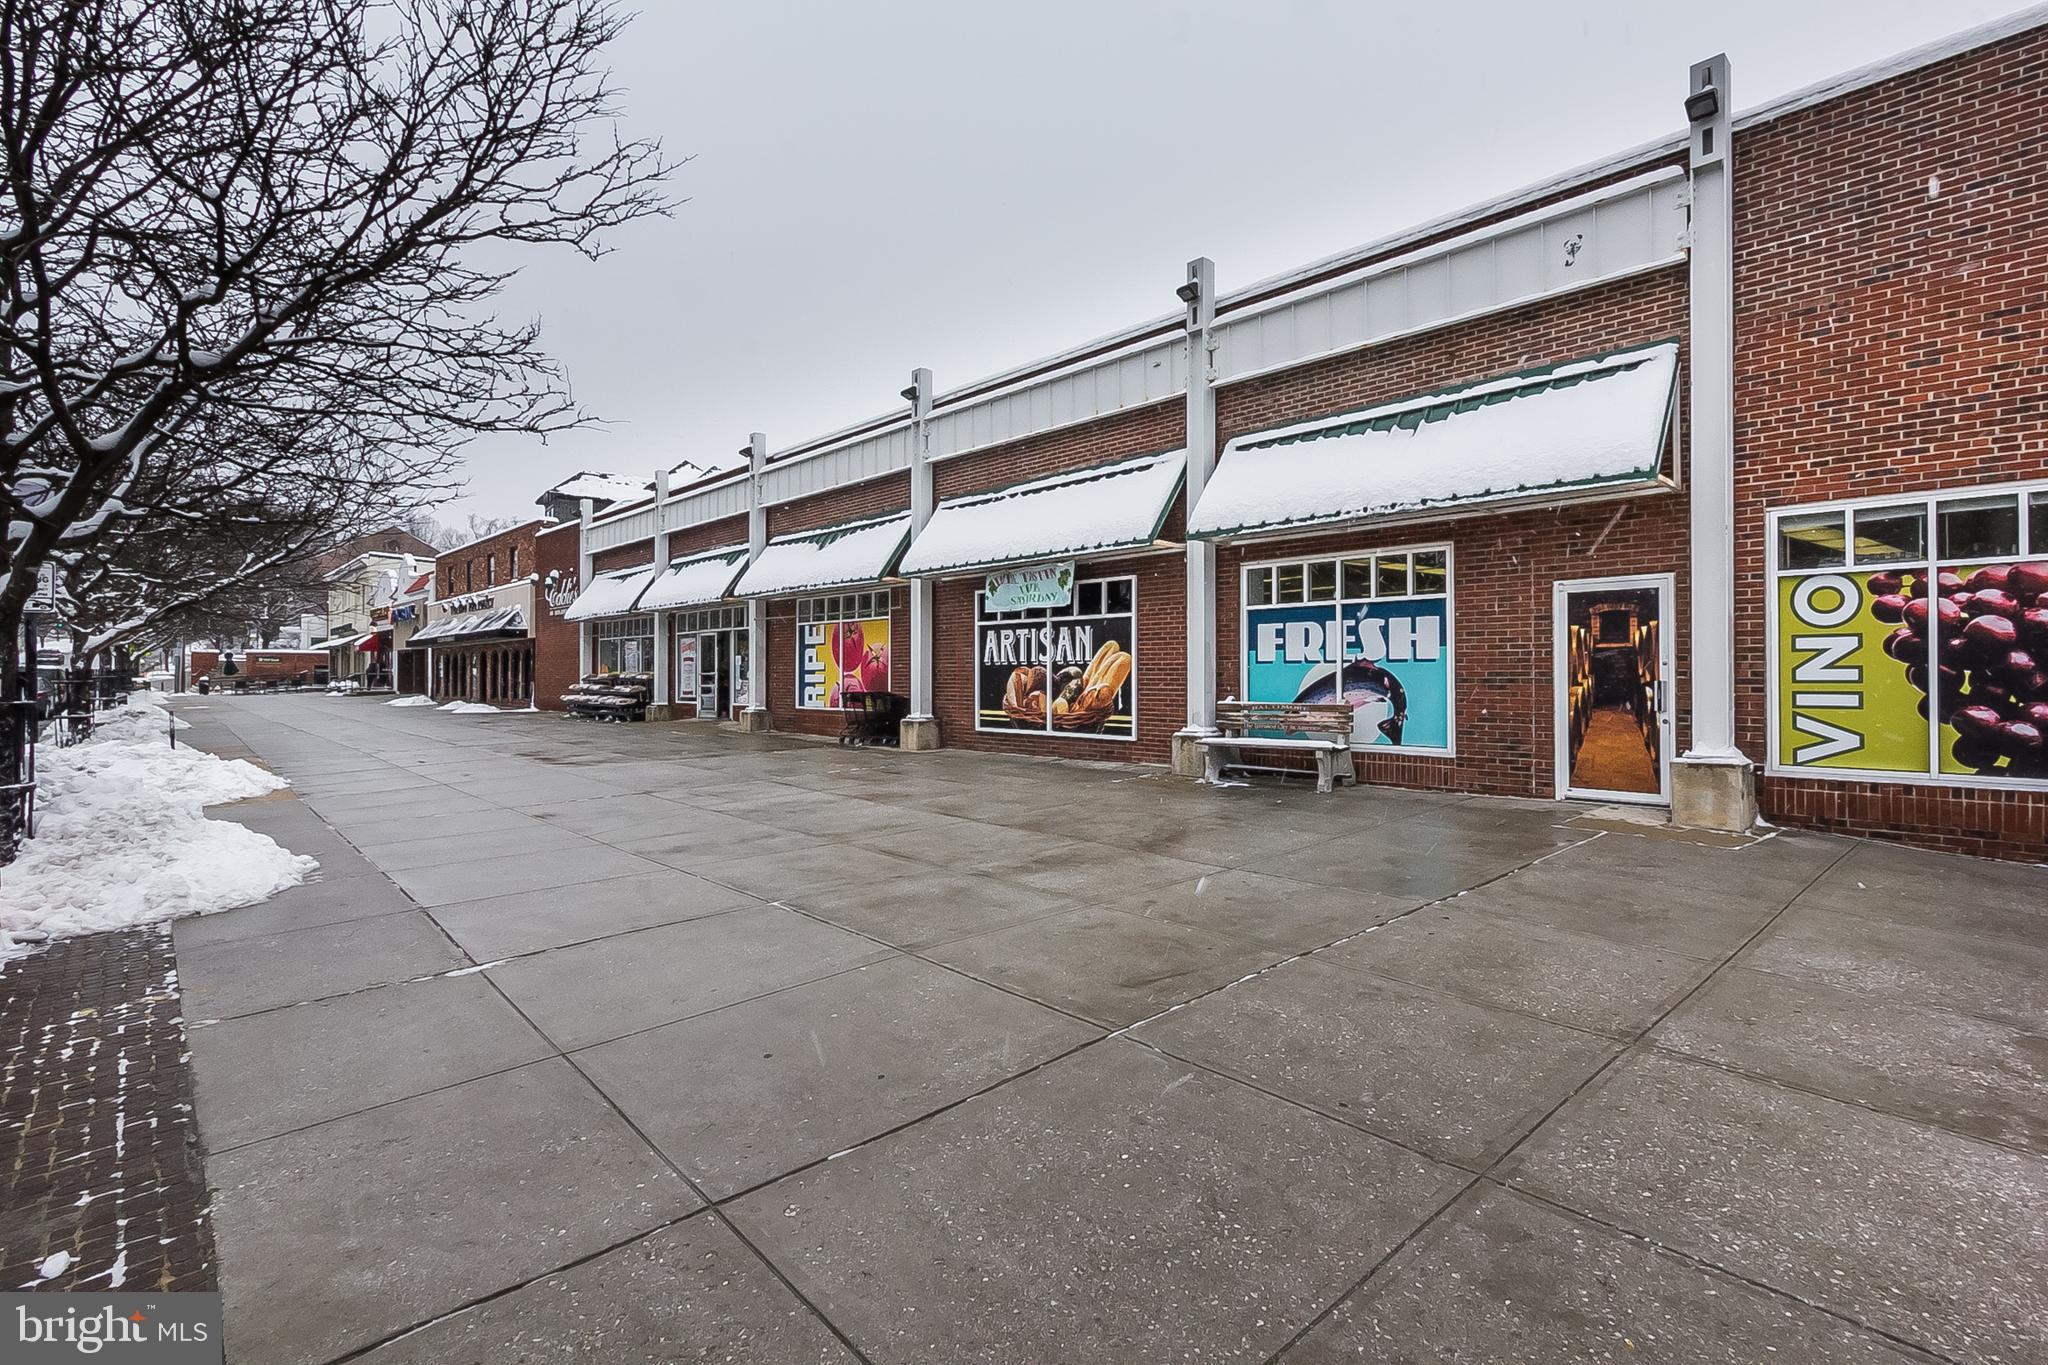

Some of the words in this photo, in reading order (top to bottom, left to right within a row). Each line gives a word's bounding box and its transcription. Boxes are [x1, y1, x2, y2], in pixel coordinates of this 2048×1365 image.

[804, 624, 826, 709] RIPE
[983, 625, 1093, 666] ARTISAN
[1257, 616, 1440, 664] FRESH
[1791, 574, 1865, 766] VINO
